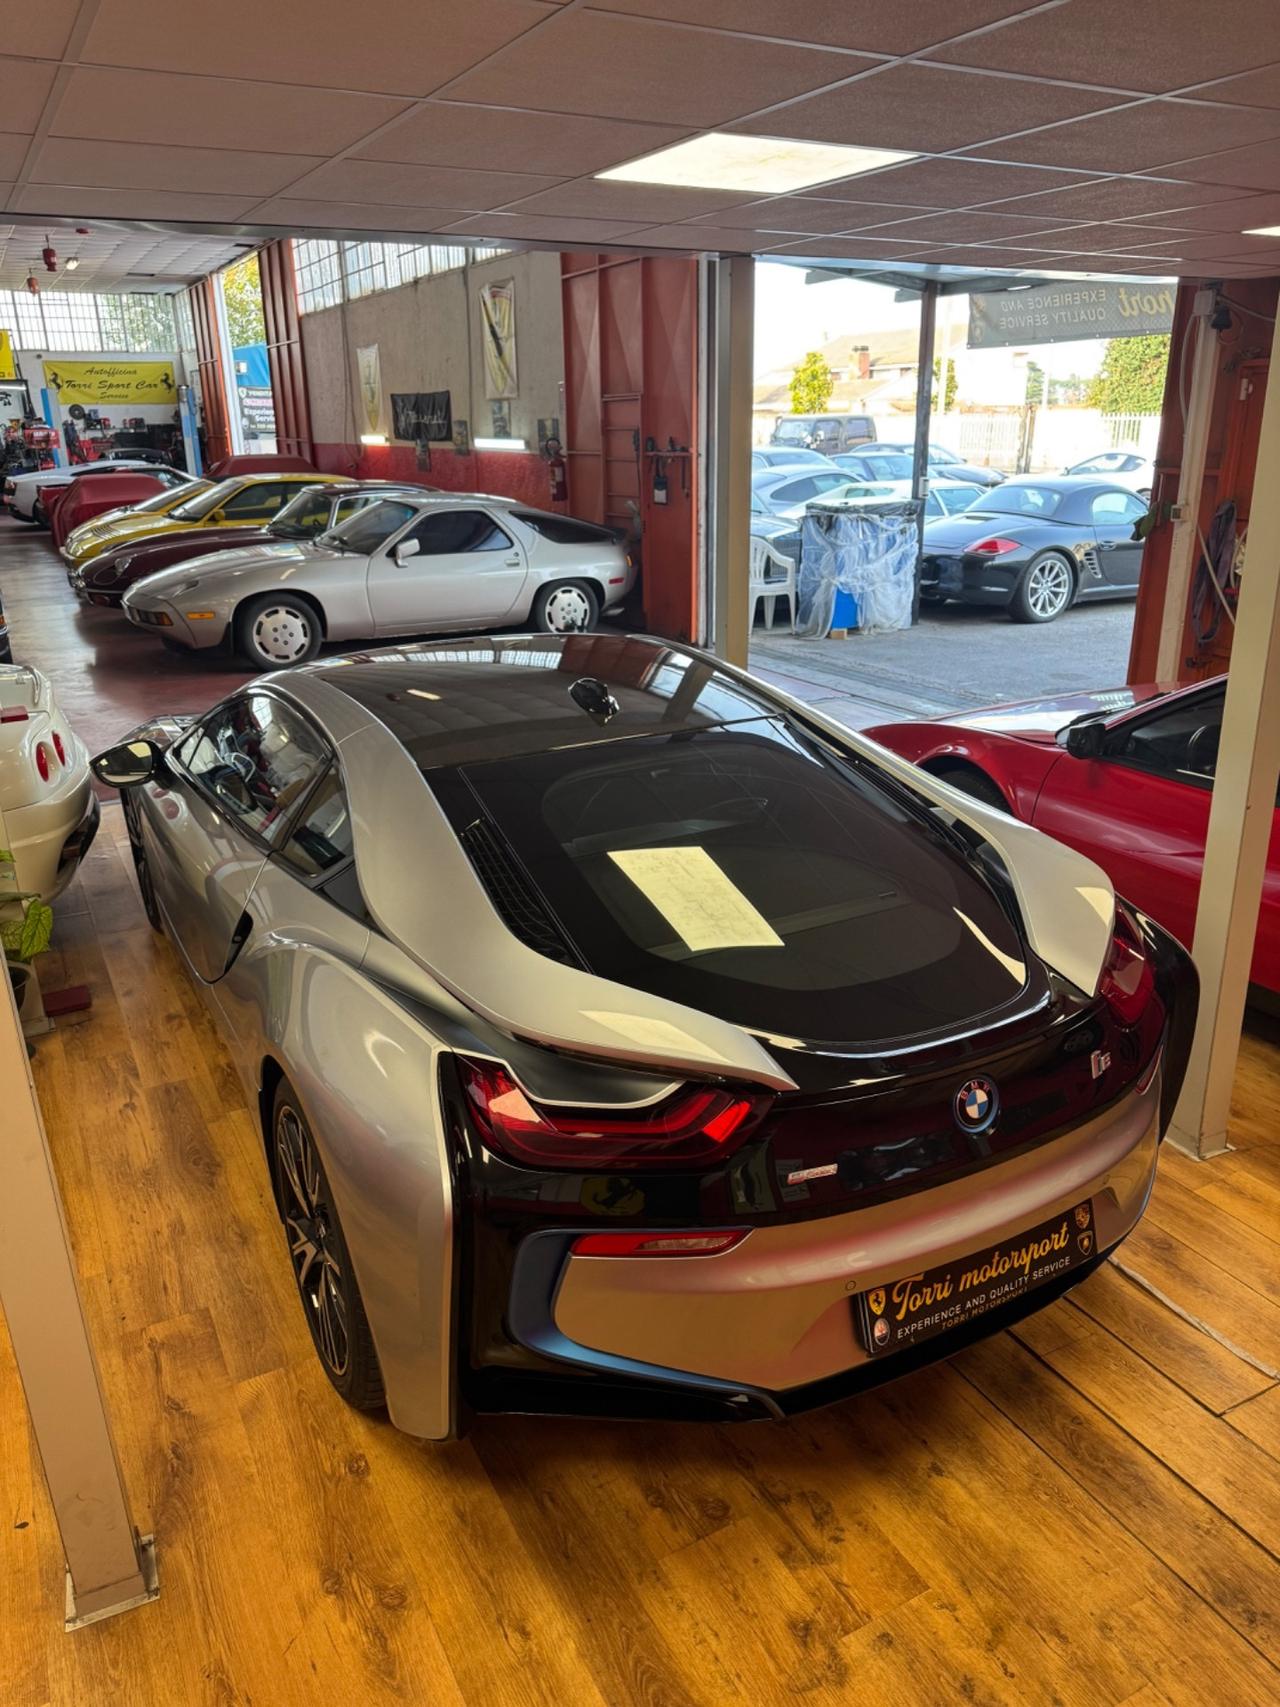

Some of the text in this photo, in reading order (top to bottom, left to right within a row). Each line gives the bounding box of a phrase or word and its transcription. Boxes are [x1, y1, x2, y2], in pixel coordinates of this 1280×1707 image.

[65, 379, 159, 391] Torri Sport Car
[891, 1221, 1070, 1321] Torri motorsport
[897, 1256, 1071, 1339] EXPERIENCE AND QUALITY SERVICE
[941, 1312, 969, 1331] TORRI
